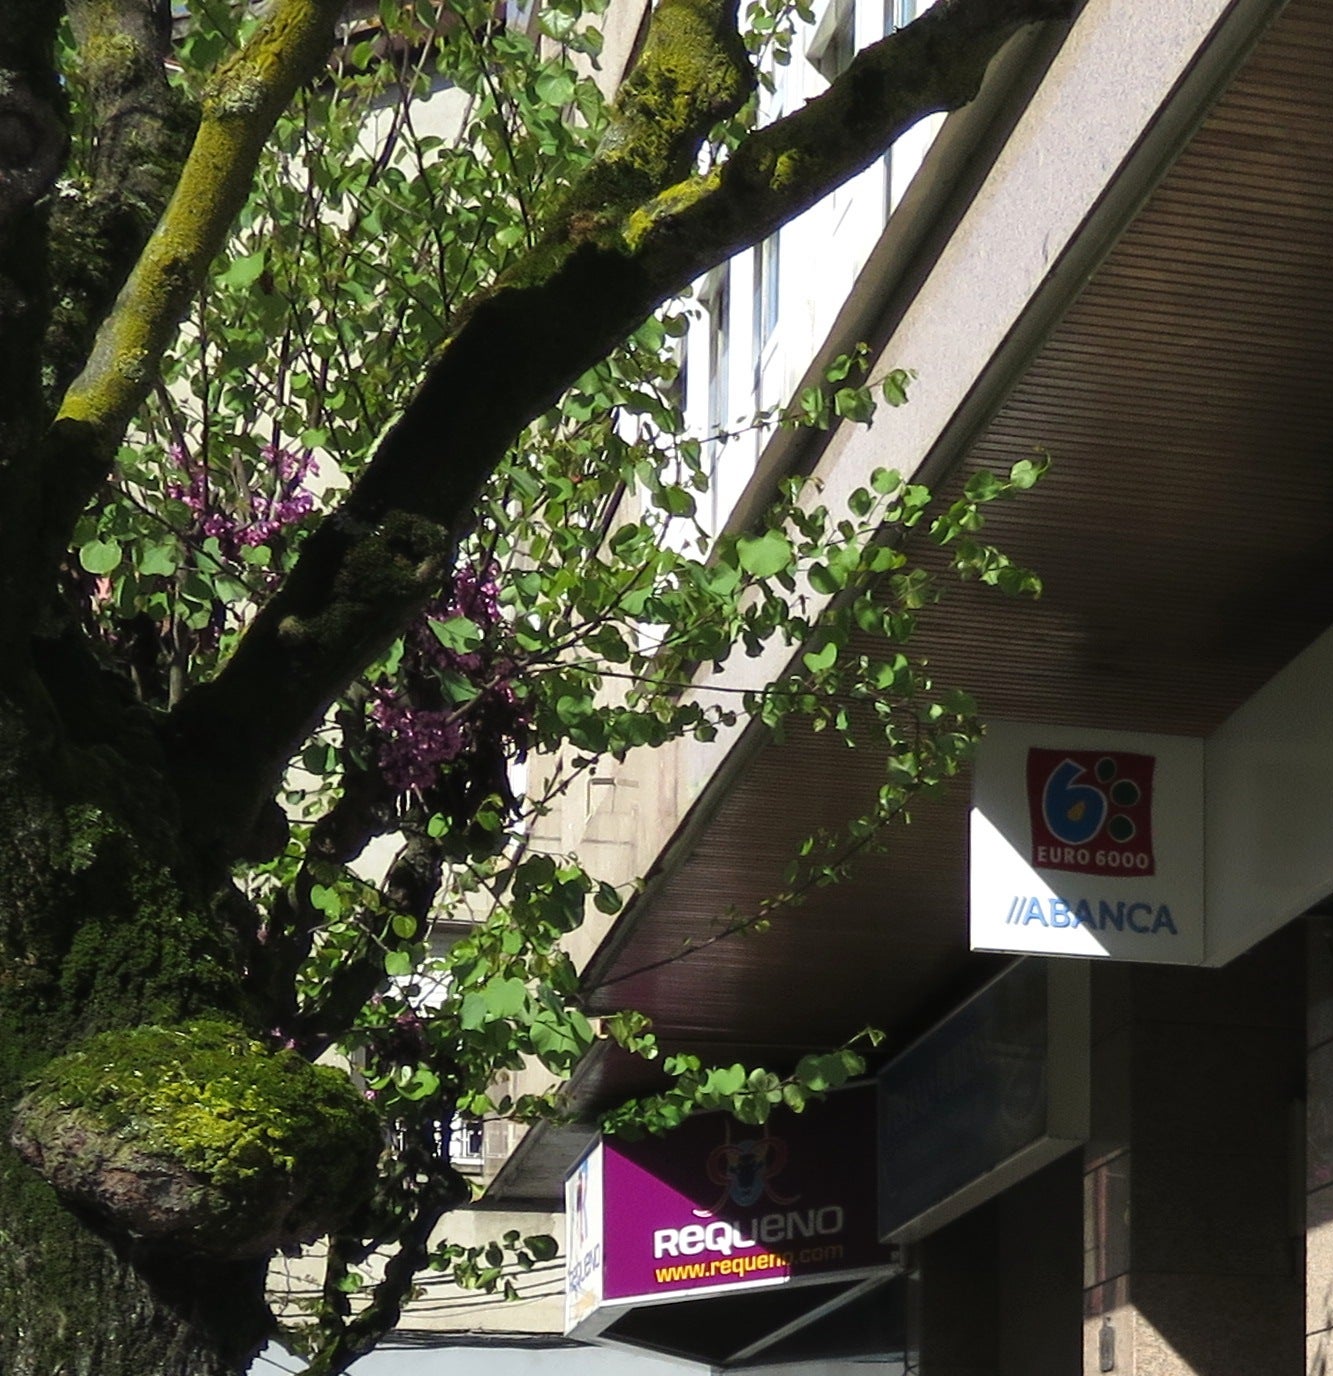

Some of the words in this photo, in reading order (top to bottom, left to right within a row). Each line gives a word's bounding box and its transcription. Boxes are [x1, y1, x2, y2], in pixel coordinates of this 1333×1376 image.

[1037, 846, 1090, 866] EURO
[1095, 850, 1149, 869] 6000
[653, 1205, 844, 1259] REQUENO
[655, 1244, 844, 1283] www.requeno.com
